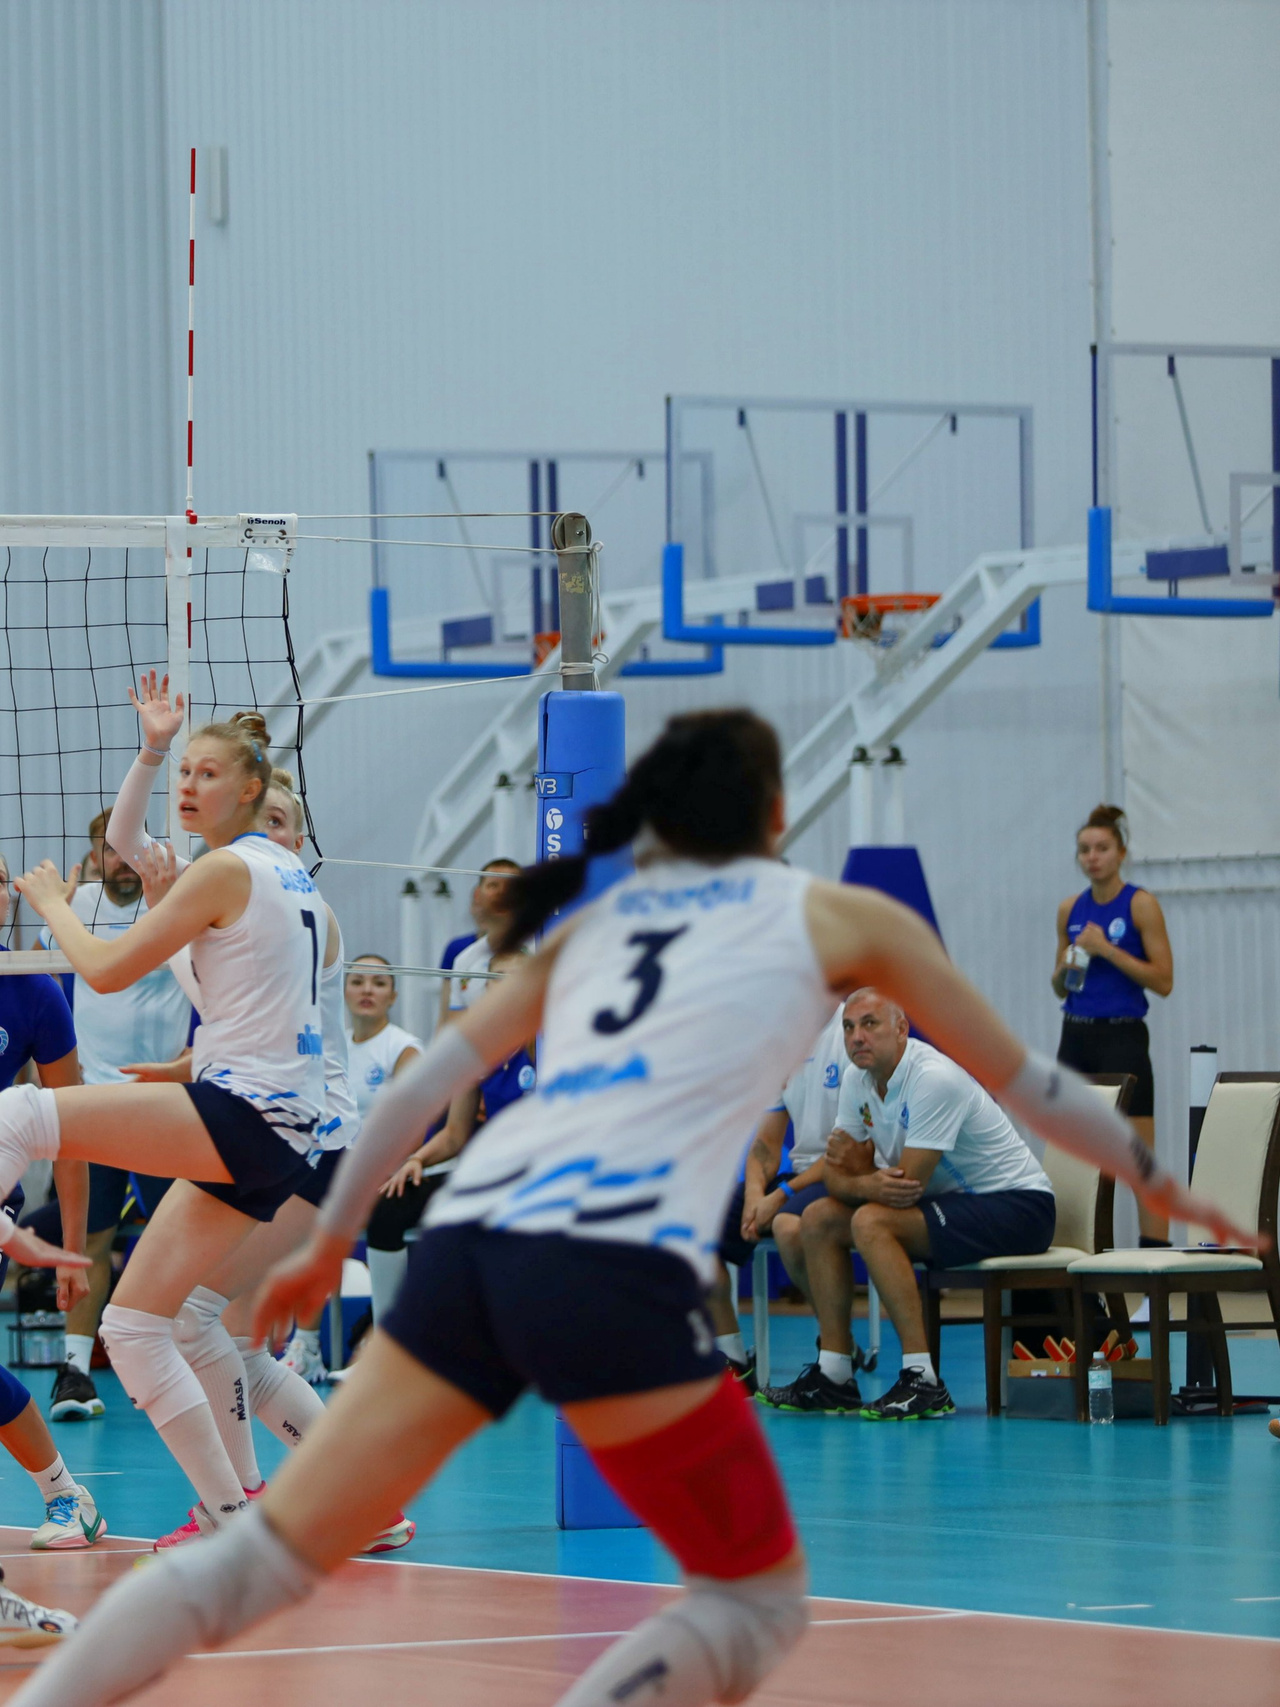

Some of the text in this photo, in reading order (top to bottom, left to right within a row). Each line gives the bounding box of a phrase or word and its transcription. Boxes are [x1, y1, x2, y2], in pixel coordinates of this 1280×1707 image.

[254, 517, 286, 526] Senoh
[590, 924, 689, 1035] 3
[233, 1377, 247, 1422] MIKASA
